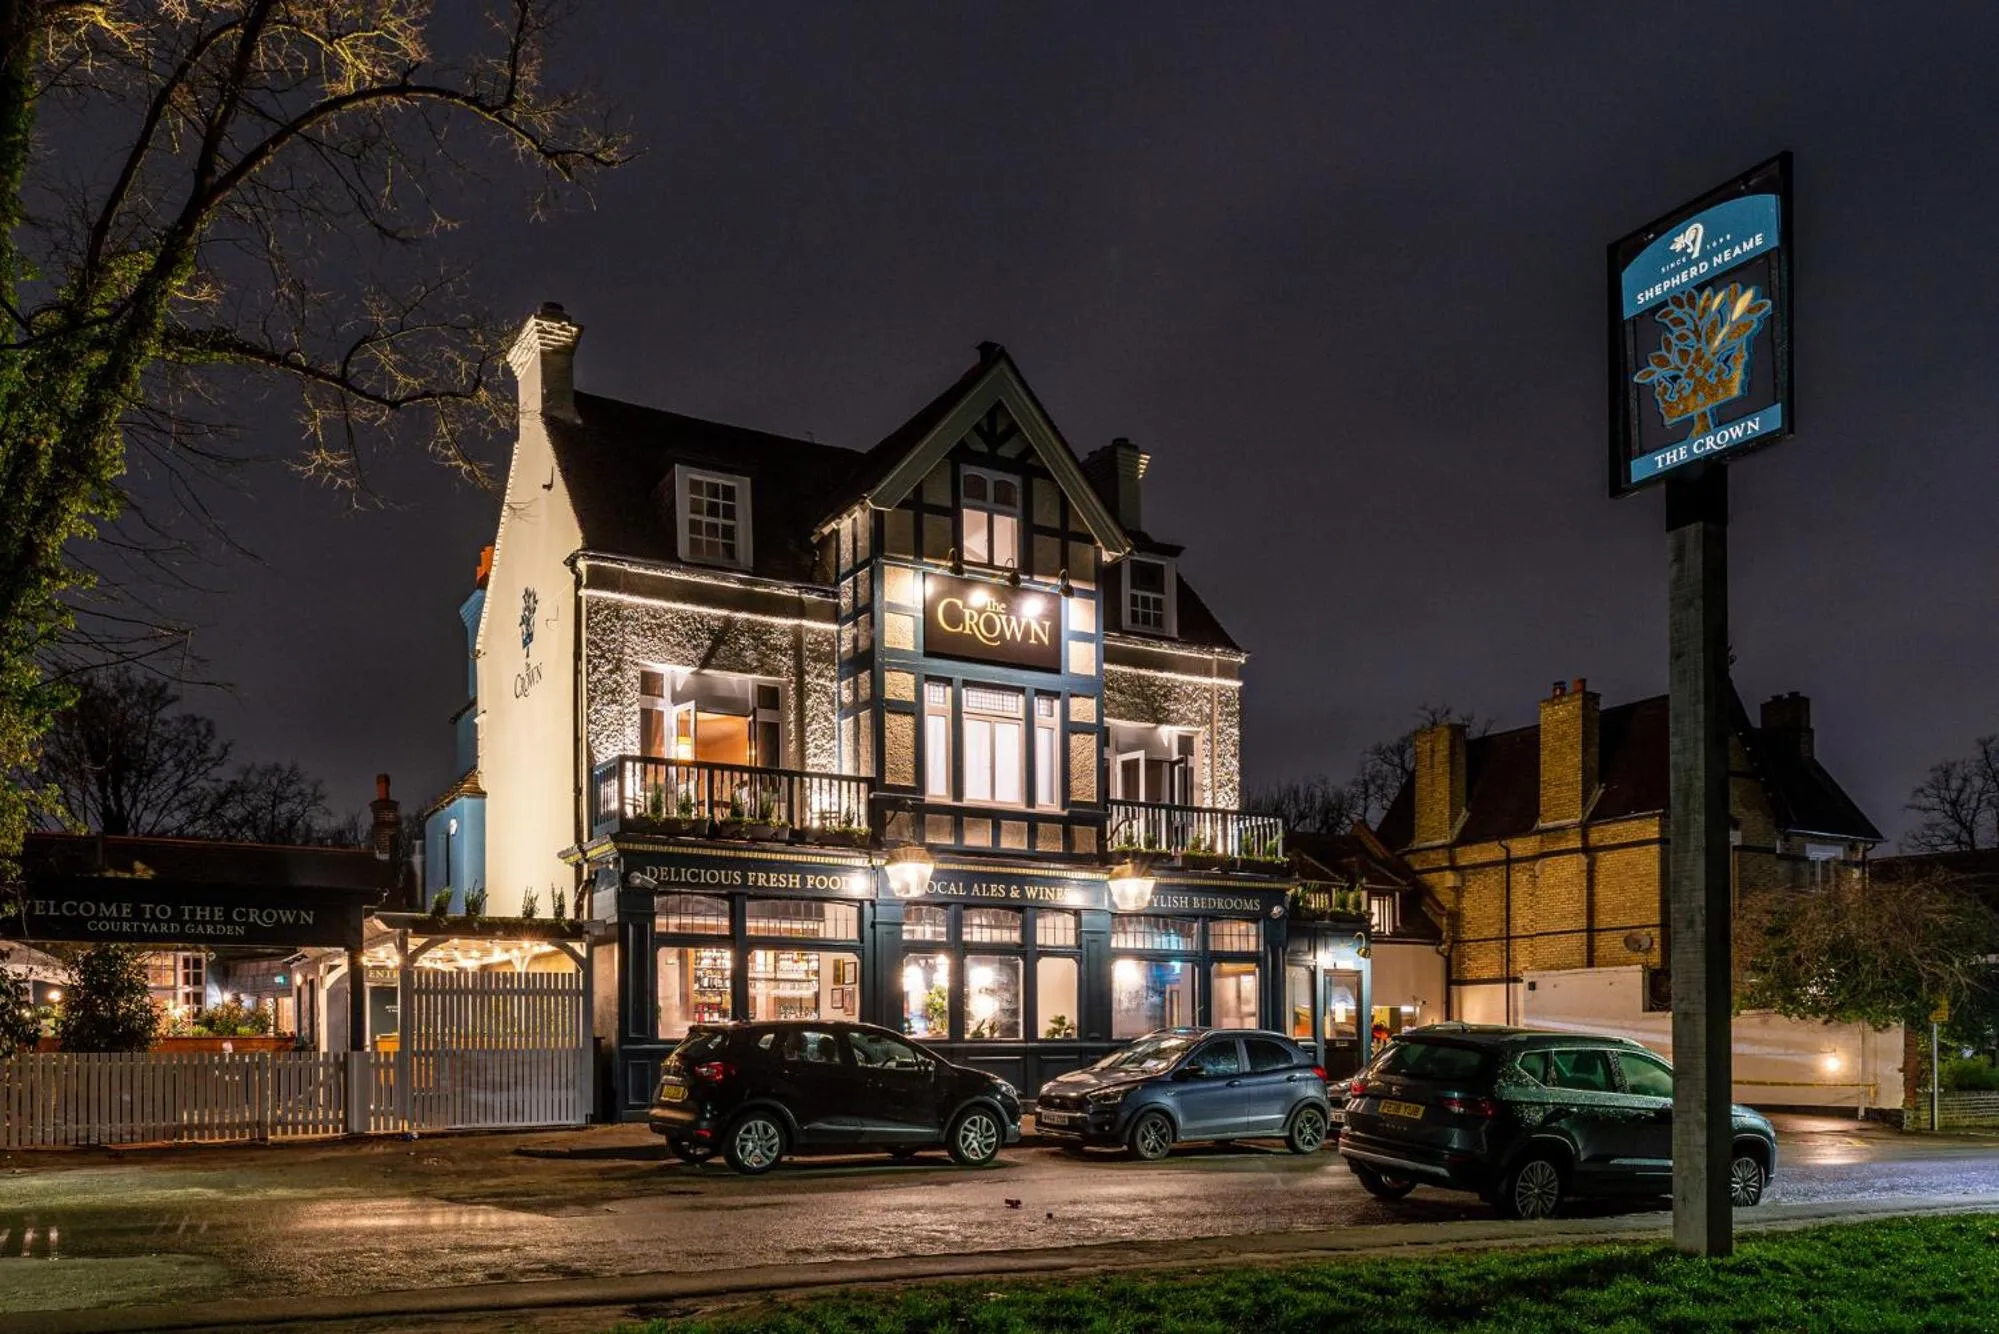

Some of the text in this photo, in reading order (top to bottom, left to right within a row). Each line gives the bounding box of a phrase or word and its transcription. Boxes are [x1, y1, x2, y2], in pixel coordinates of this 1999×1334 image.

[1636, 233, 1764, 305] SHEPHERD NEAME
[1660, 256, 1687, 273] SINCE
[1654, 416, 1760, 469] THE CROWN
[937, 598, 1051, 646] CROWN
[645, 866, 742, 885] DELICIOUS
[747, 872, 801, 889] FRESH
[920, 880, 1068, 900] OCAL ALES & WINE
[1148, 895, 1261, 911] YLISH BEDROOMS
[140, 903, 172, 919] TO
[180, 905, 225, 921] THE
[232, 907, 316, 927] CROWN
[87, 920, 246, 936] COURTYARD GARDEN
